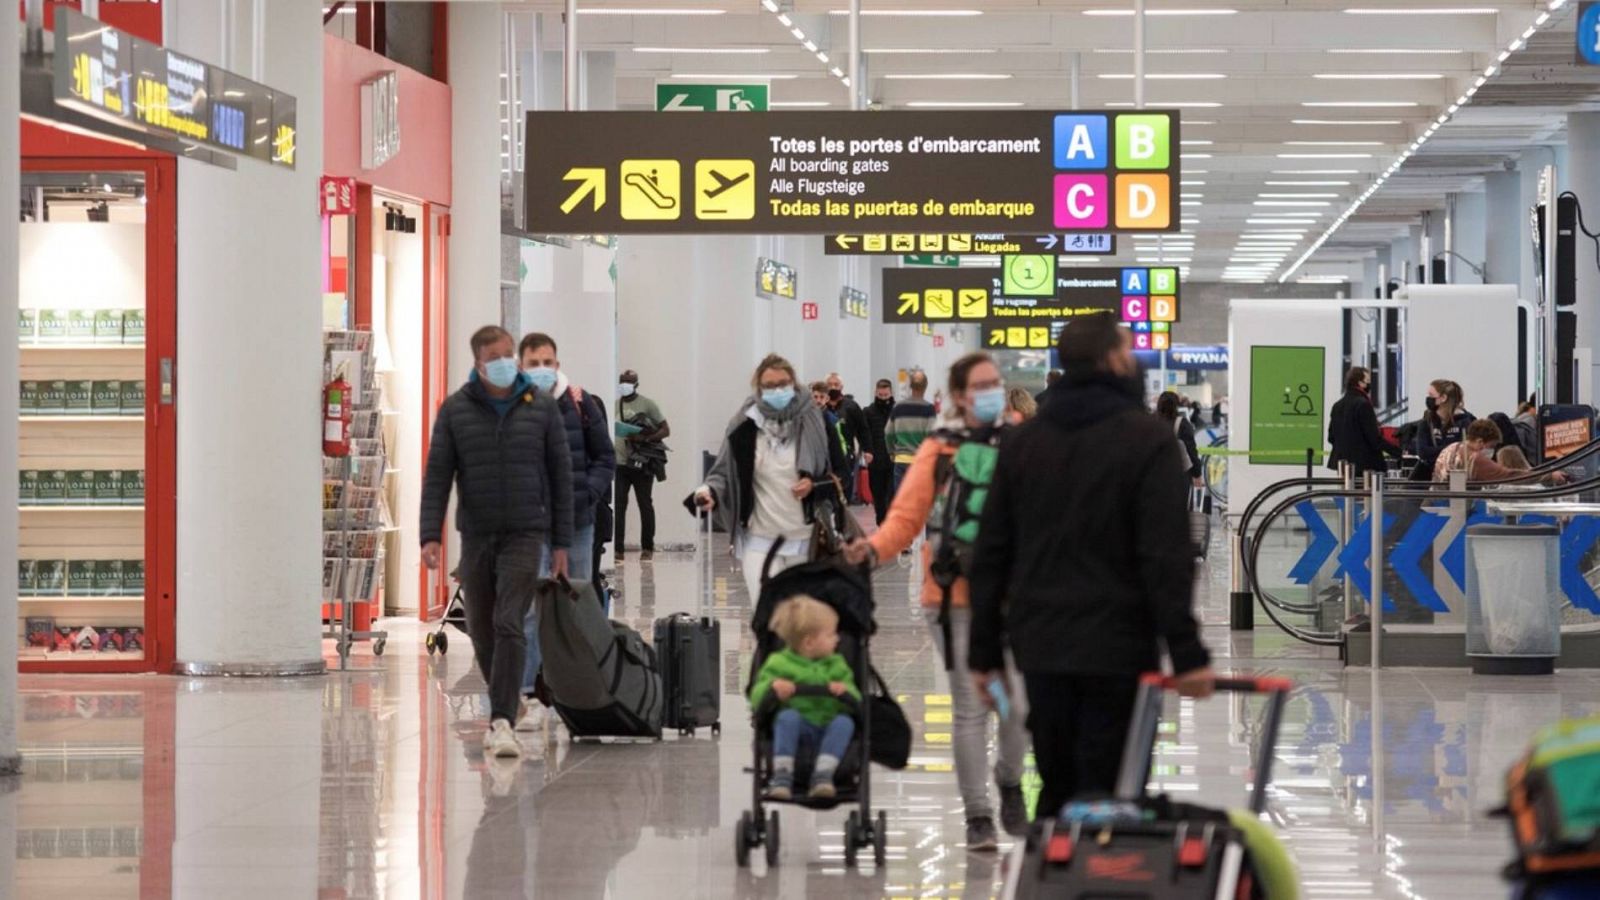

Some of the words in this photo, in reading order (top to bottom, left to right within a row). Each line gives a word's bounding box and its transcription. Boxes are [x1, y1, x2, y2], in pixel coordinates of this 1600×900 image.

[769, 136, 817, 154] Totes
[820, 136, 846, 154] les
[849, 137, 904, 157] portes
[907, 136, 1041, 154] d'embarcament
[1066, 123, 1096, 160] A
[1128, 123, 1156, 160] B
[769, 157, 787, 173] All
[789, 157, 849, 175] boarding
[851, 158, 890, 175] gates
[769, 178, 795, 194] Alle
[797, 178, 866, 197] Flugsteige
[769, 199, 822, 216] Todas
[825, 199, 851, 216] las
[853, 200, 919, 219] puertas
[922, 199, 945, 216] de
[948, 199, 1036, 219] embarque
[1065, 182, 1096, 219] C
[1127, 182, 1157, 219] D
[974, 241, 1021, 254] Llegadas
[1127, 272, 1142, 290] A
[1156, 273, 1170, 291] B
[992, 306, 1017, 316] Todas
[1127, 299, 1142, 318] C
[1155, 299, 1170, 318] D
[1136, 334, 1147, 348] C
[1181, 352, 1228, 364] RYANA
